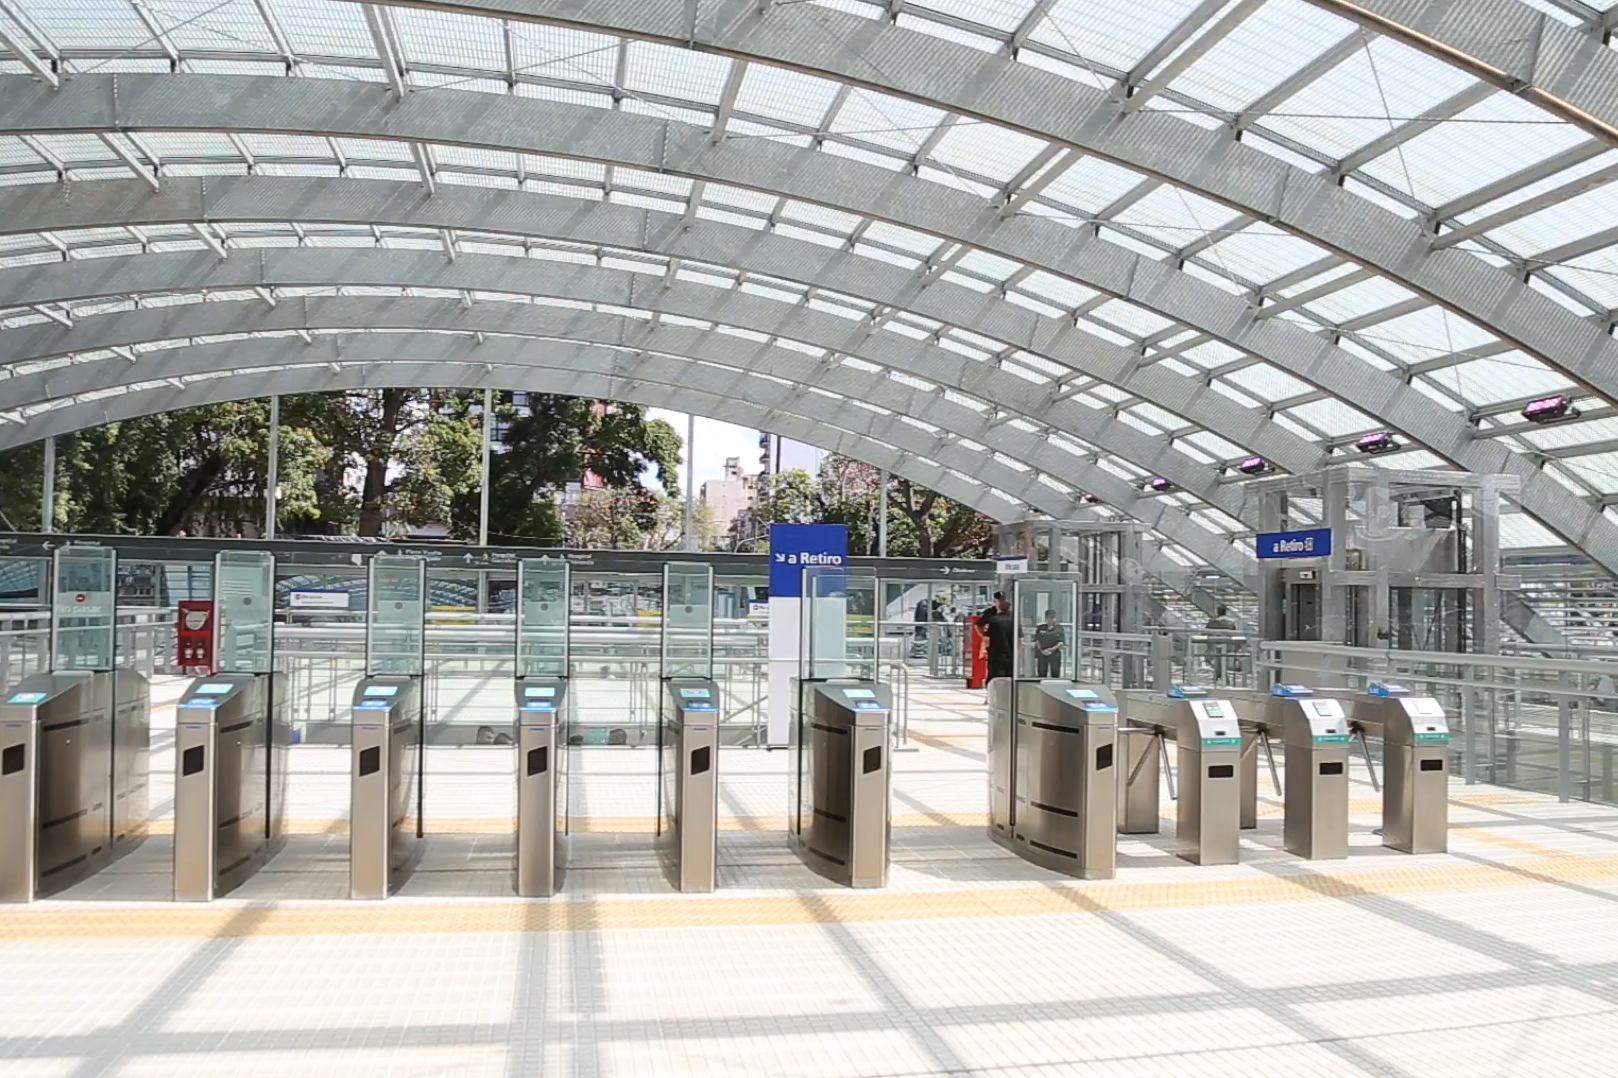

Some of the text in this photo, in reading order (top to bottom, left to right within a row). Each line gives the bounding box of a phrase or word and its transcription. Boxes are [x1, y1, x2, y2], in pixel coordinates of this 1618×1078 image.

[1273, 539, 1304, 553] a Retiro
[787, 552, 842, 565] a Retiro
[72, 605, 103, 614] pasar
